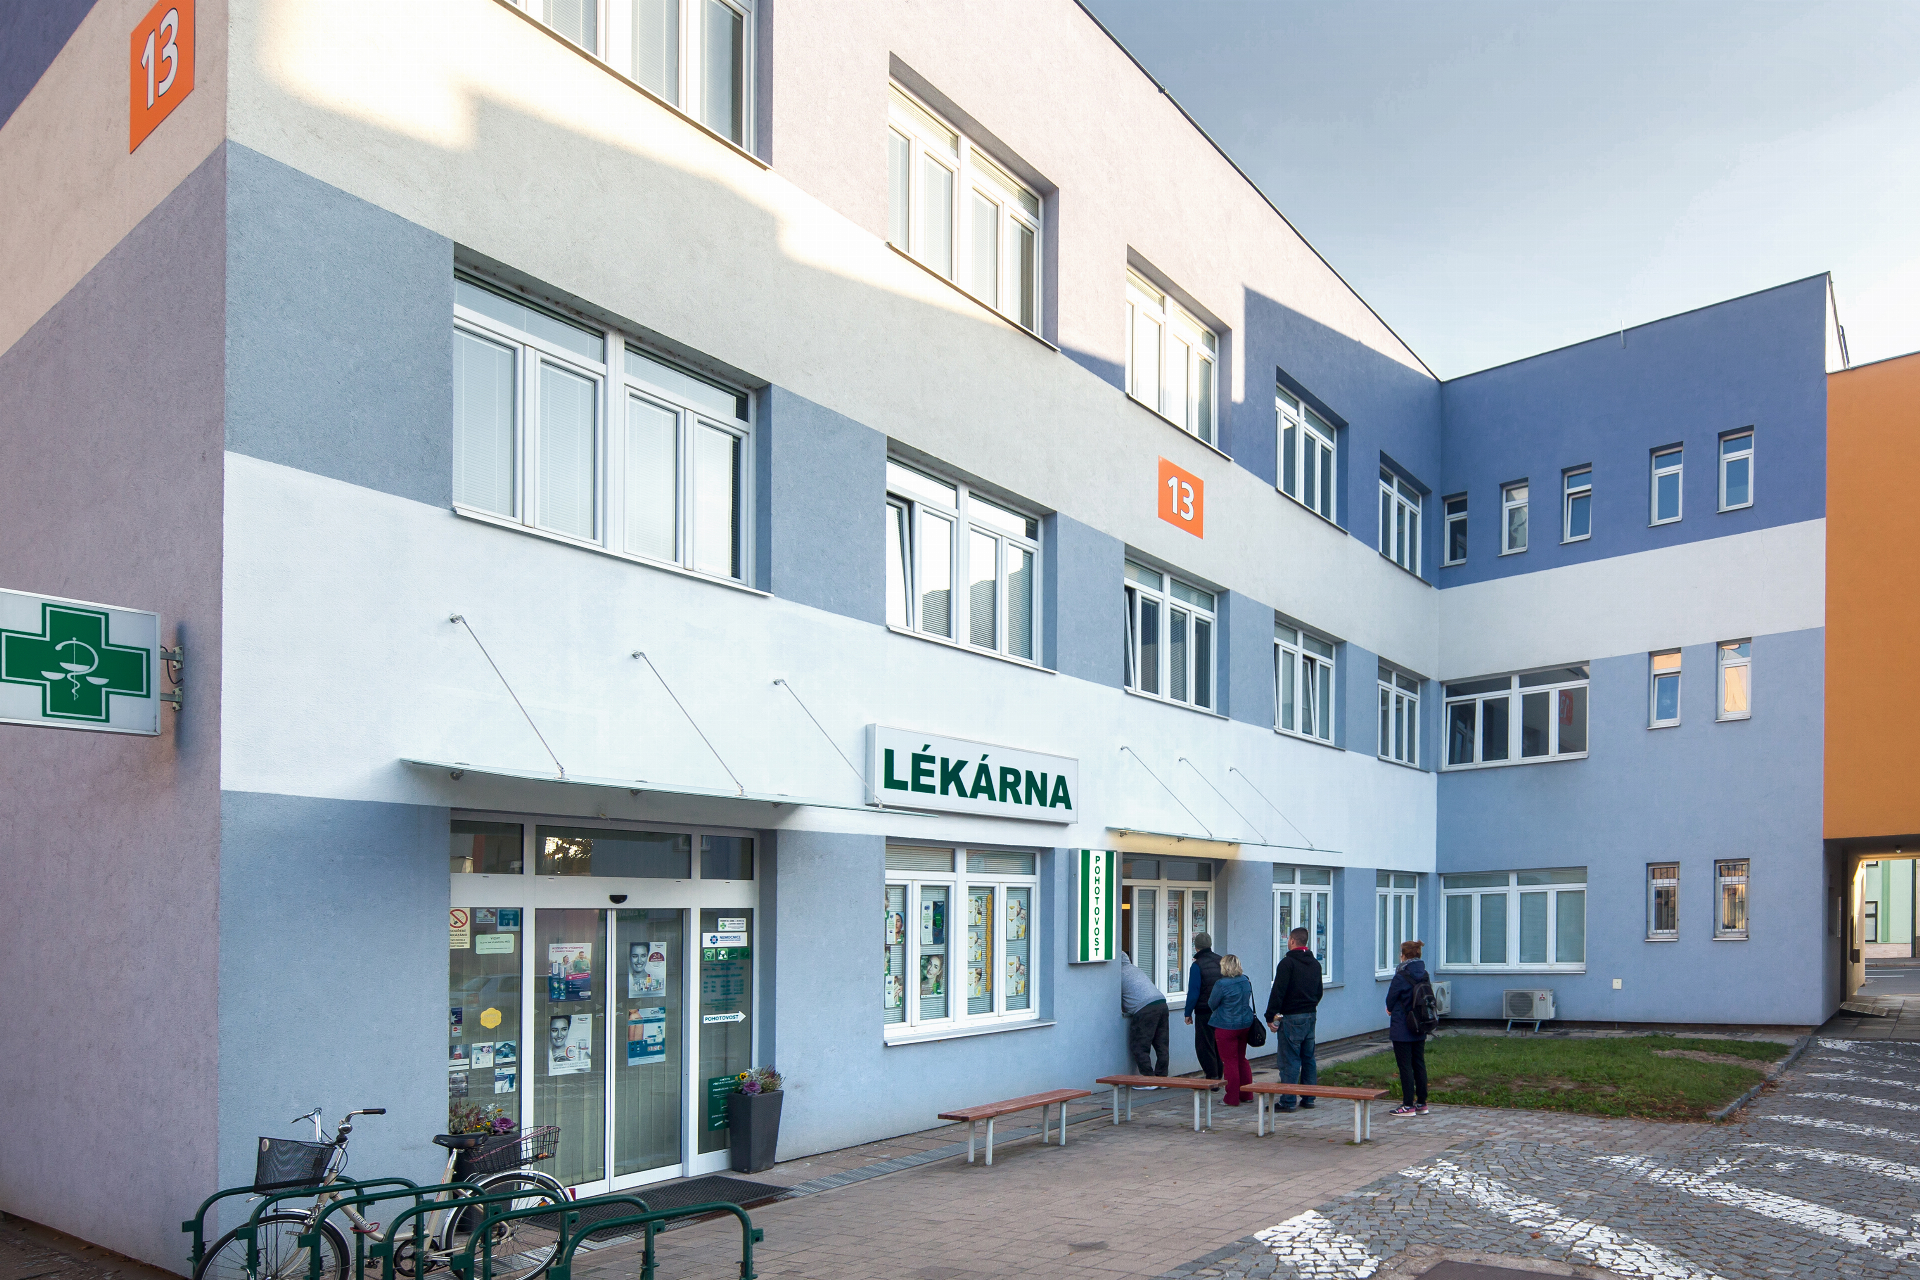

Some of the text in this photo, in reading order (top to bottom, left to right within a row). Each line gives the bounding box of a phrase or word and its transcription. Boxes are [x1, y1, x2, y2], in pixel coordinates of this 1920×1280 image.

[140, 7, 179, 111] 13
[1167, 475, 1195, 522] 13
[883, 743, 1073, 810] LÉKÁRNA
[704, 1014, 739, 1022] POHOTOVOST
